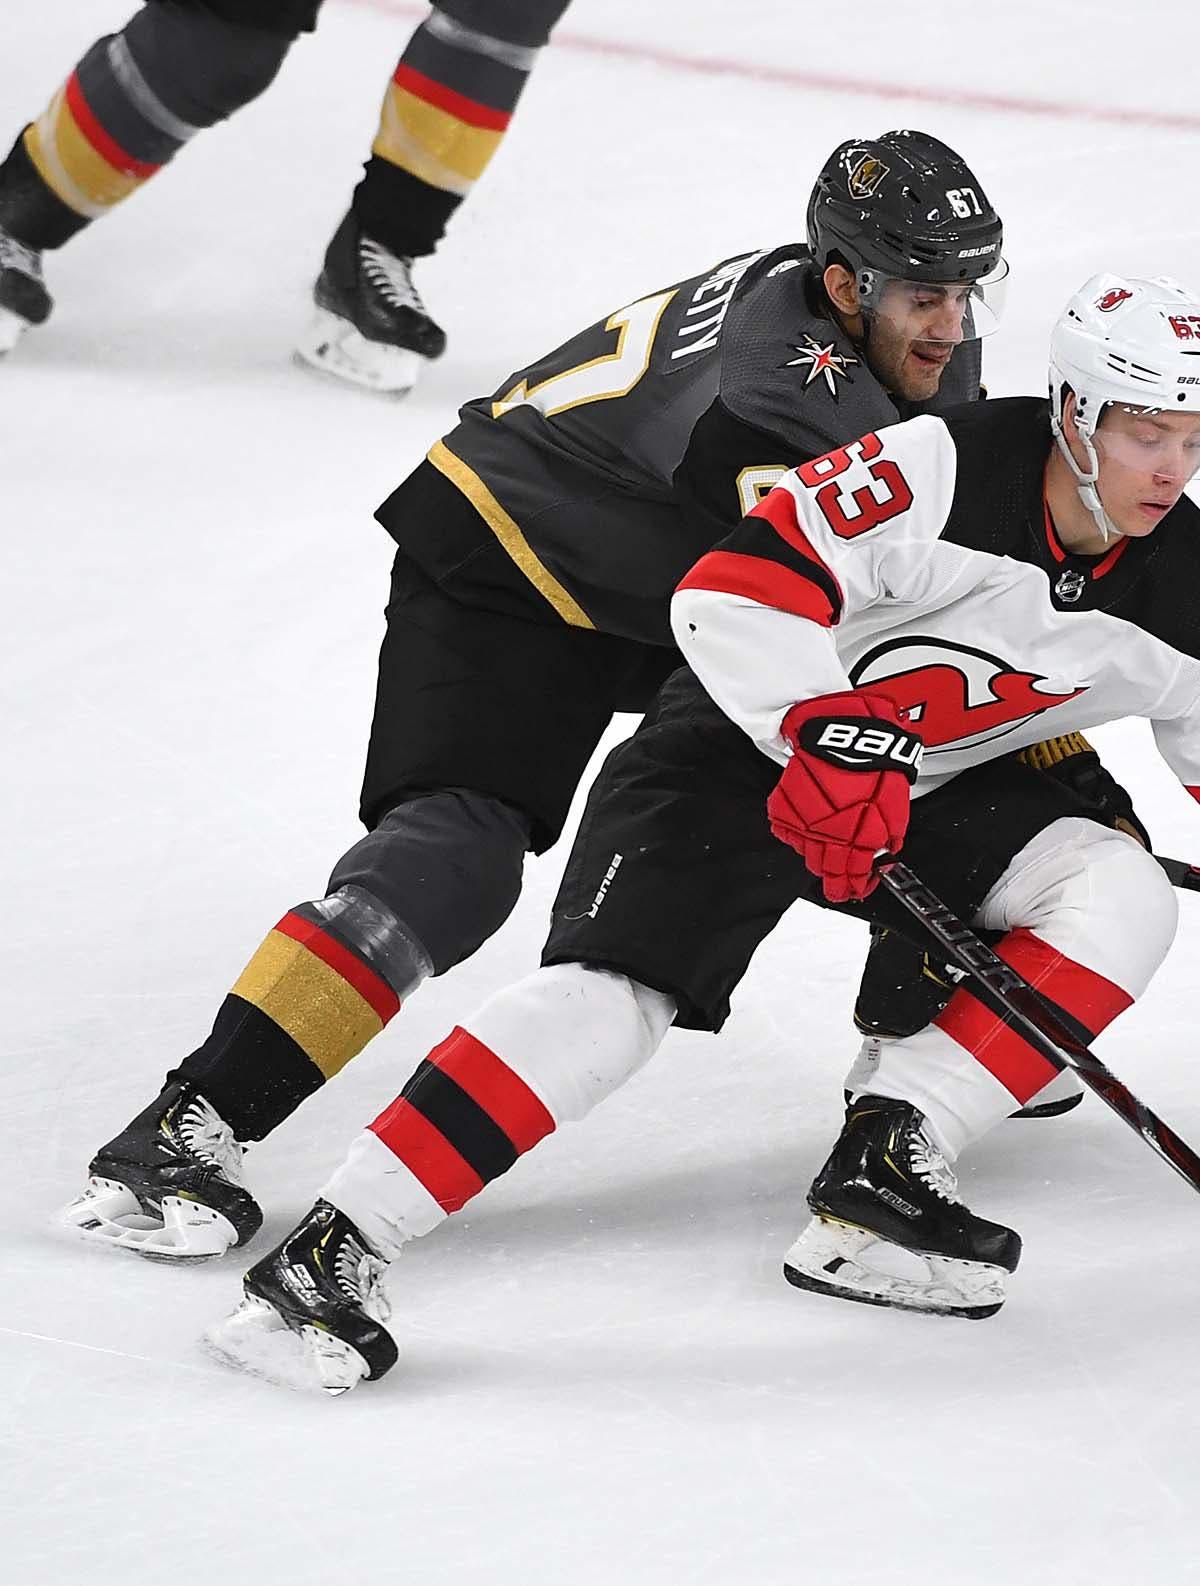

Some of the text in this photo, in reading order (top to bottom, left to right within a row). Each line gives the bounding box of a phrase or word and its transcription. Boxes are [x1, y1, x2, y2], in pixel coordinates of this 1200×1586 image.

[945, 187, 985, 220] 67
[957, 243, 997, 259] BAUER
[795, 431, 914, 540] 63
